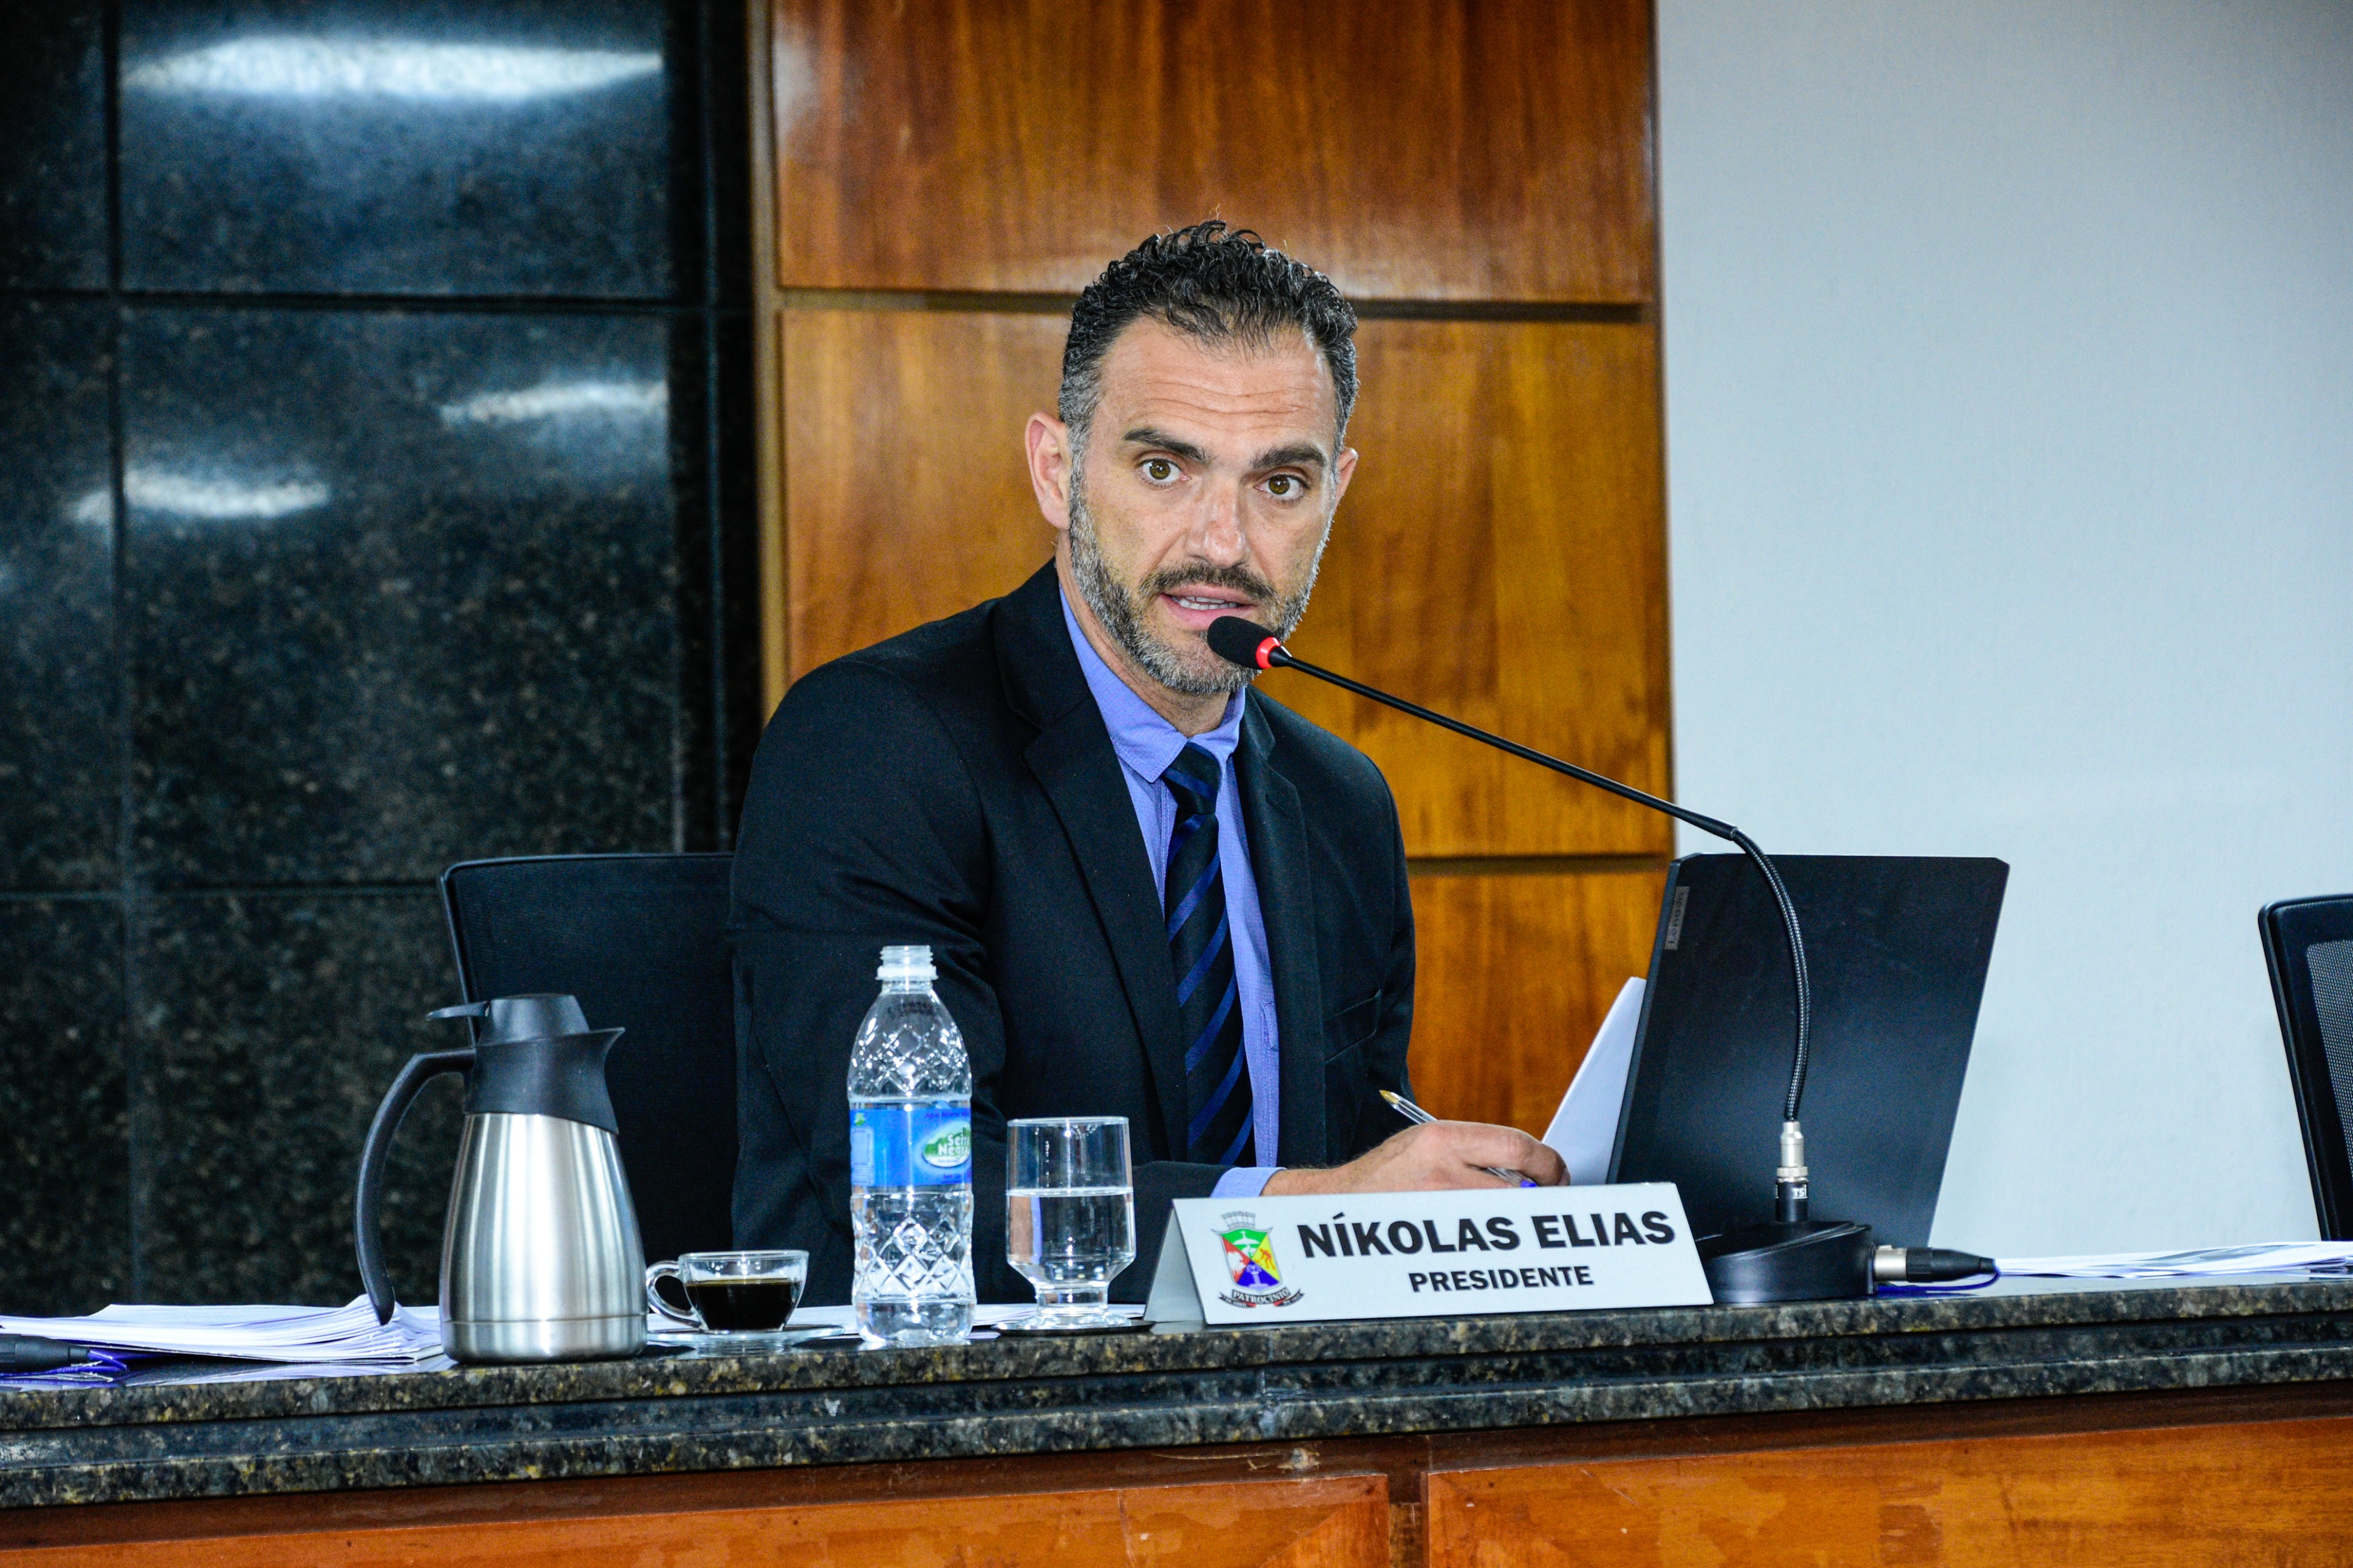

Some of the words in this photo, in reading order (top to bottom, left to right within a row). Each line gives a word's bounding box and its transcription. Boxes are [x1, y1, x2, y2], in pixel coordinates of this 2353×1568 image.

[1297, 1213, 1520, 1258] NÍKOLAS
[1531, 1211, 1675, 1248] ELIAS
[1408, 1265, 1594, 1292] PRESIDENTE
